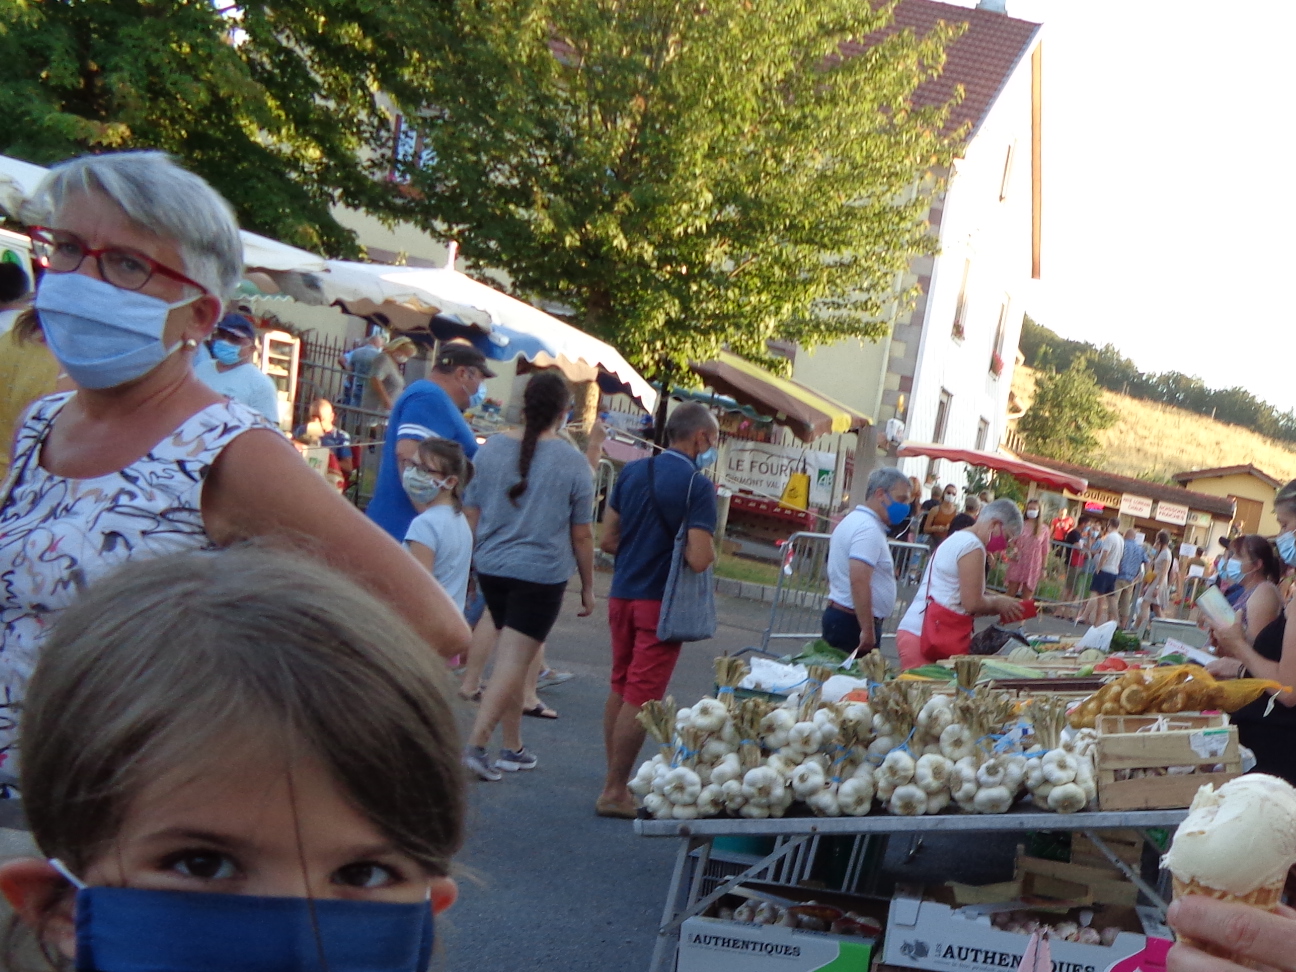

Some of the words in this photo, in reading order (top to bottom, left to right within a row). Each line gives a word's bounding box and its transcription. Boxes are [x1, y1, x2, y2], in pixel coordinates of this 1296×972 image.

[728, 457, 745, 472] LE
[1078, 490, 1121, 508] oulang
[692, 934, 802, 958] AUTHENTIQUES
